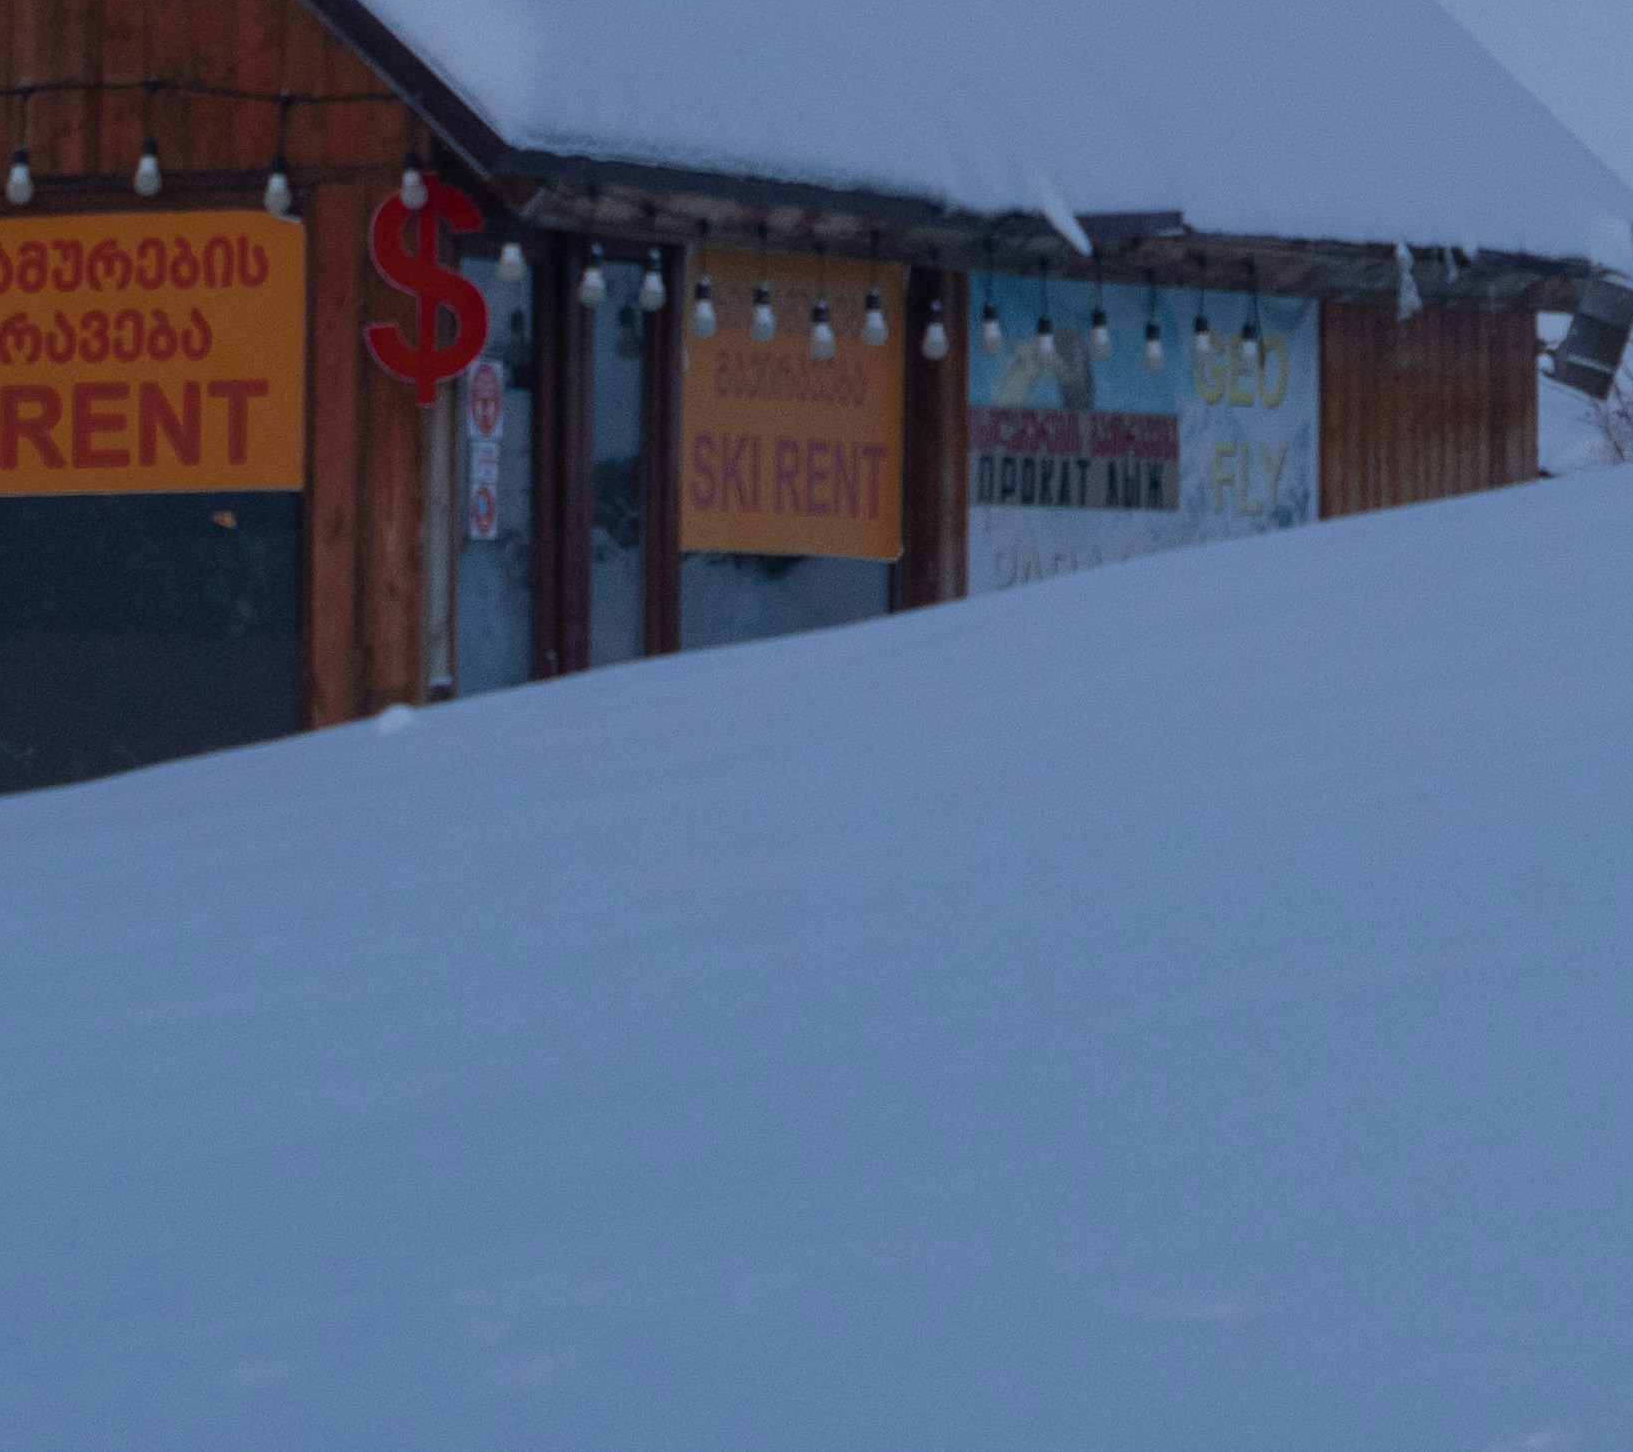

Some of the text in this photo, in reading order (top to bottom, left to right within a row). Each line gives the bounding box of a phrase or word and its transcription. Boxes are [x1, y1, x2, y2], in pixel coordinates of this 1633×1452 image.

[368, 172, 488, 406] $
[0, 380, 269, 469] RENT
[689, 433, 888, 519] SKI RENT
[1211, 440, 1288, 516] FLY
